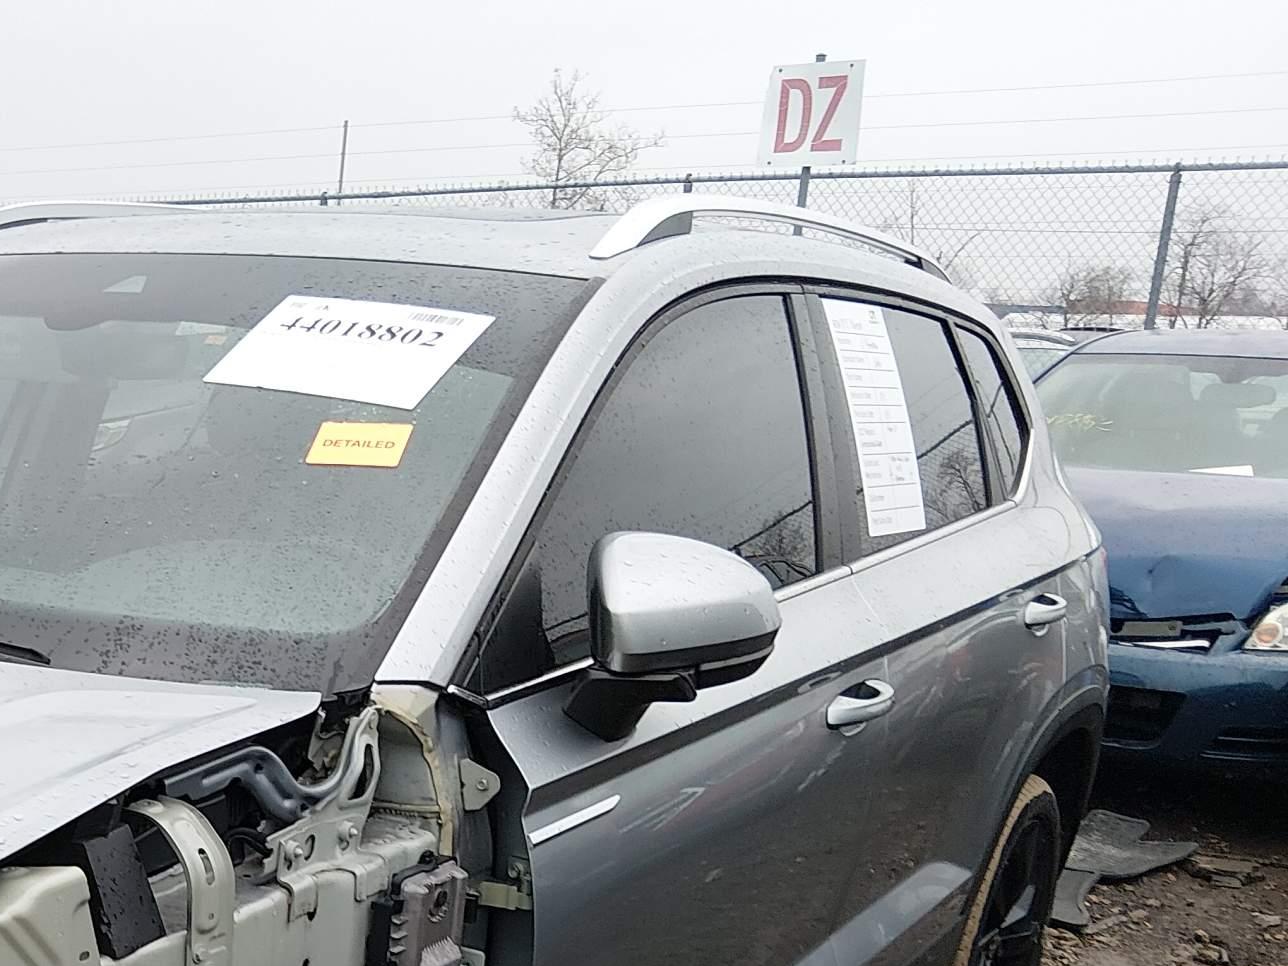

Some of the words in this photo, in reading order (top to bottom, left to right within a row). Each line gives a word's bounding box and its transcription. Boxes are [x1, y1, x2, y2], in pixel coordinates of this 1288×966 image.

[774, 76, 848, 153] DZ
[280, 316, 444, 347] 44018802
[322, 439, 396, 449] DETAILED
